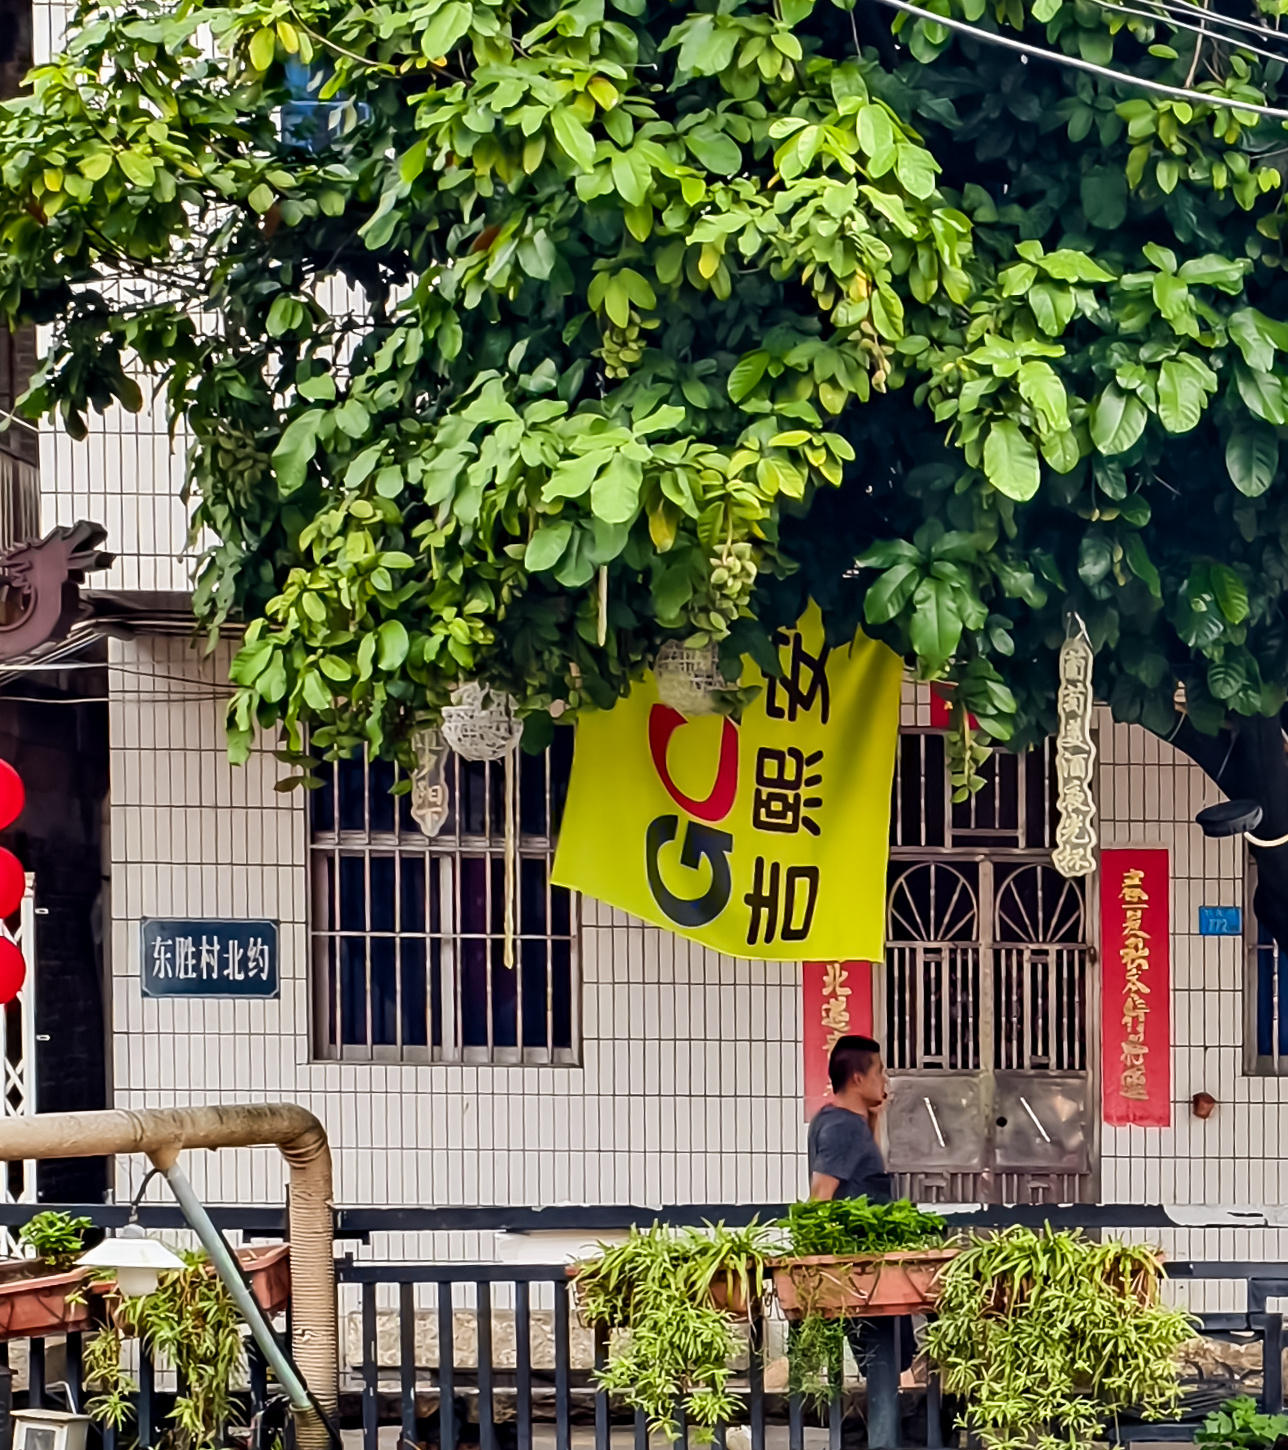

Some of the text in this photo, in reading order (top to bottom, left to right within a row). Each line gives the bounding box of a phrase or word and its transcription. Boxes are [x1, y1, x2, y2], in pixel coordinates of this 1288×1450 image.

[151, 935, 269, 981] 东胜村北约
